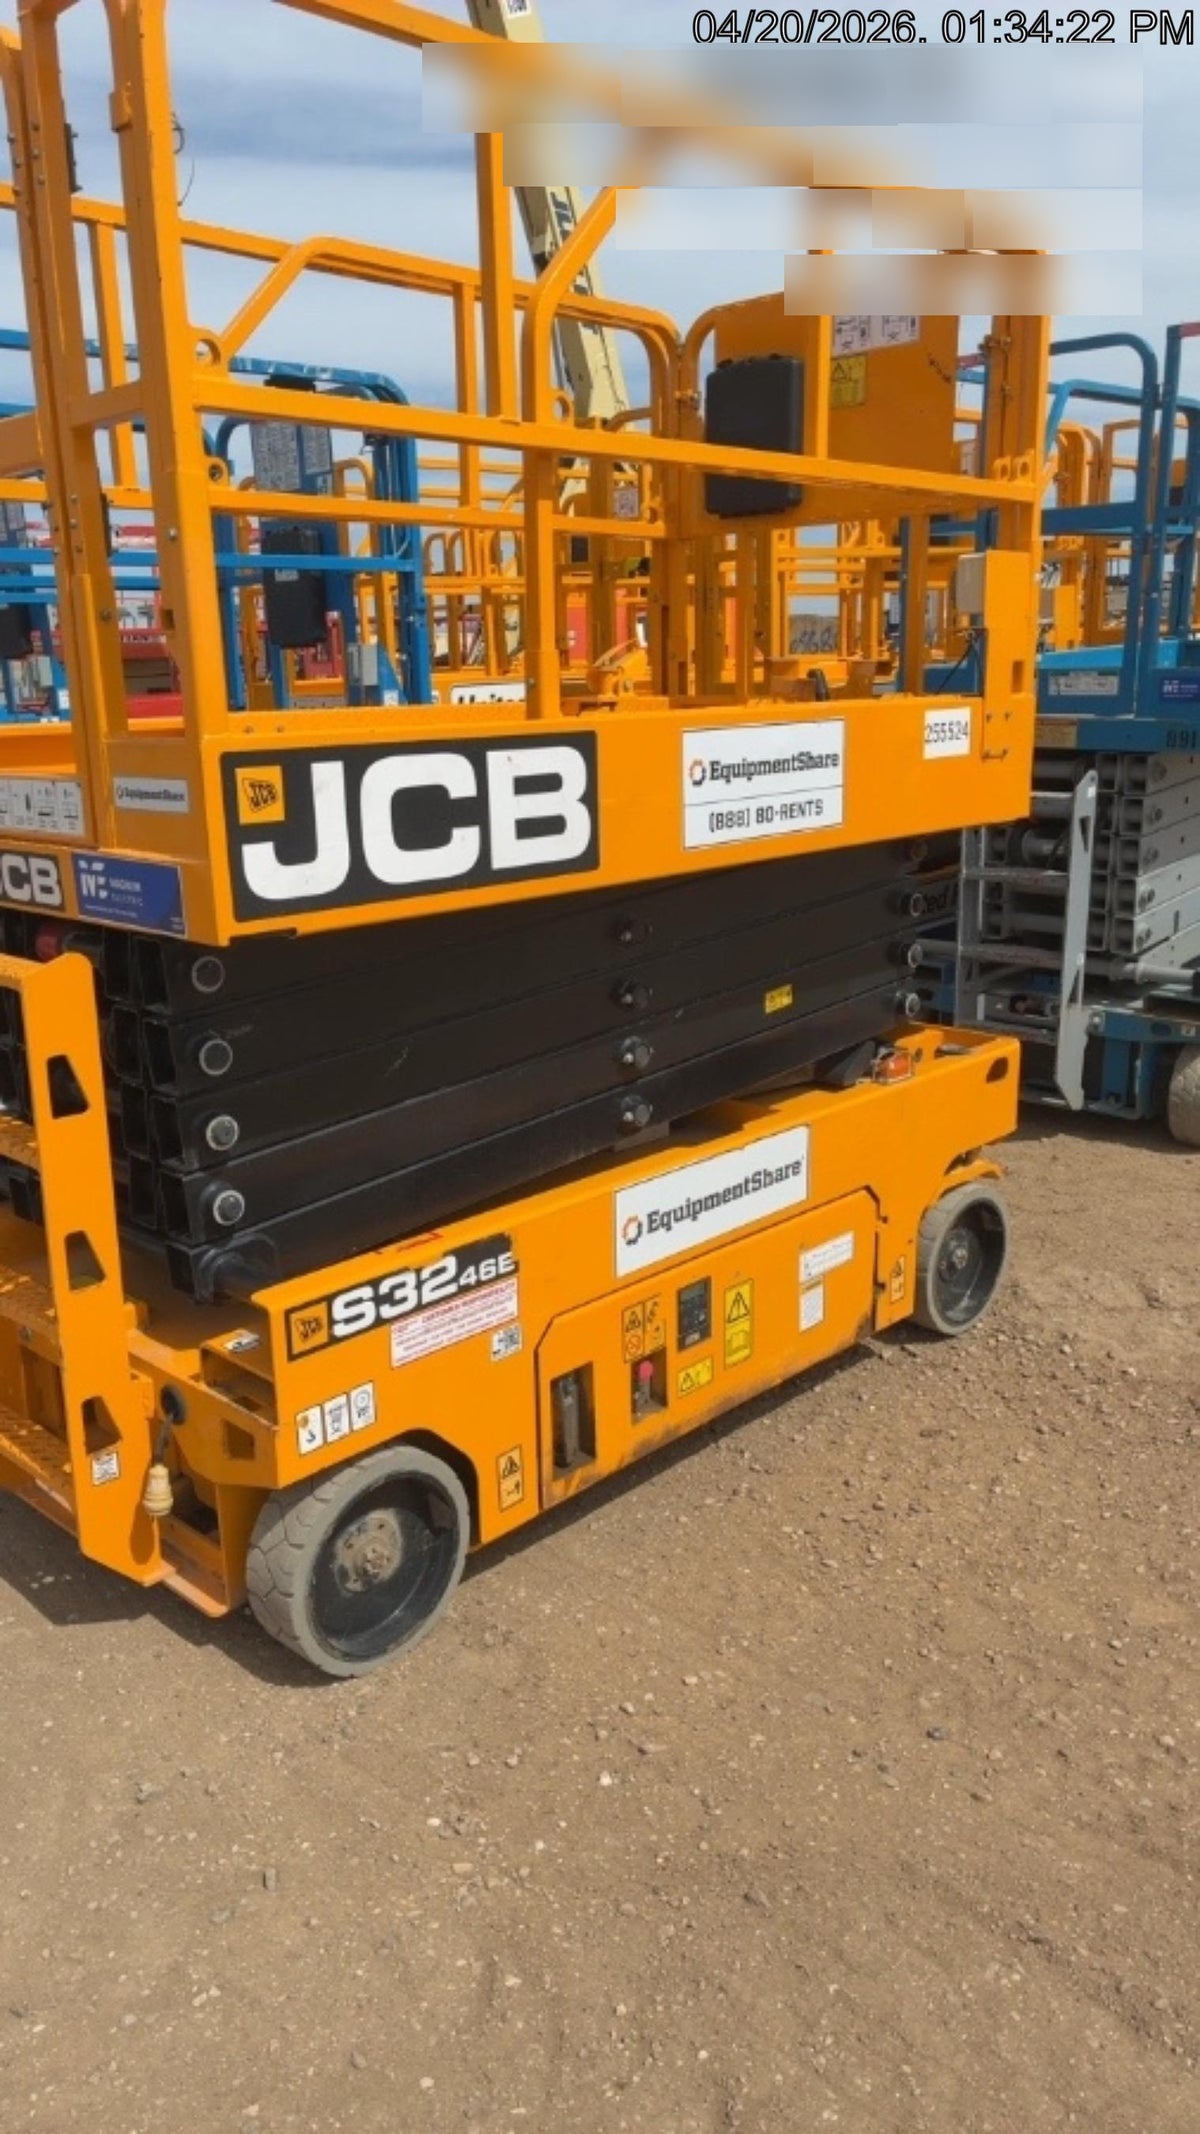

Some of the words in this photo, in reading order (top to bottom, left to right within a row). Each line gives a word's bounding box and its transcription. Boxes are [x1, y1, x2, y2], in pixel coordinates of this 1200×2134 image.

[924, 721, 969, 743] 255524
[708, 751, 840, 784] EquipmentShare
[241, 745, 592, 901] JCB
[755, 798, 824, 824] 80-RENTS
[0, 853, 63, 907] CB
[646, 1159, 802, 1234] EquipmentShare
[331, 1255, 458, 1339] S32
[458, 1251, 516, 1287] 46E
